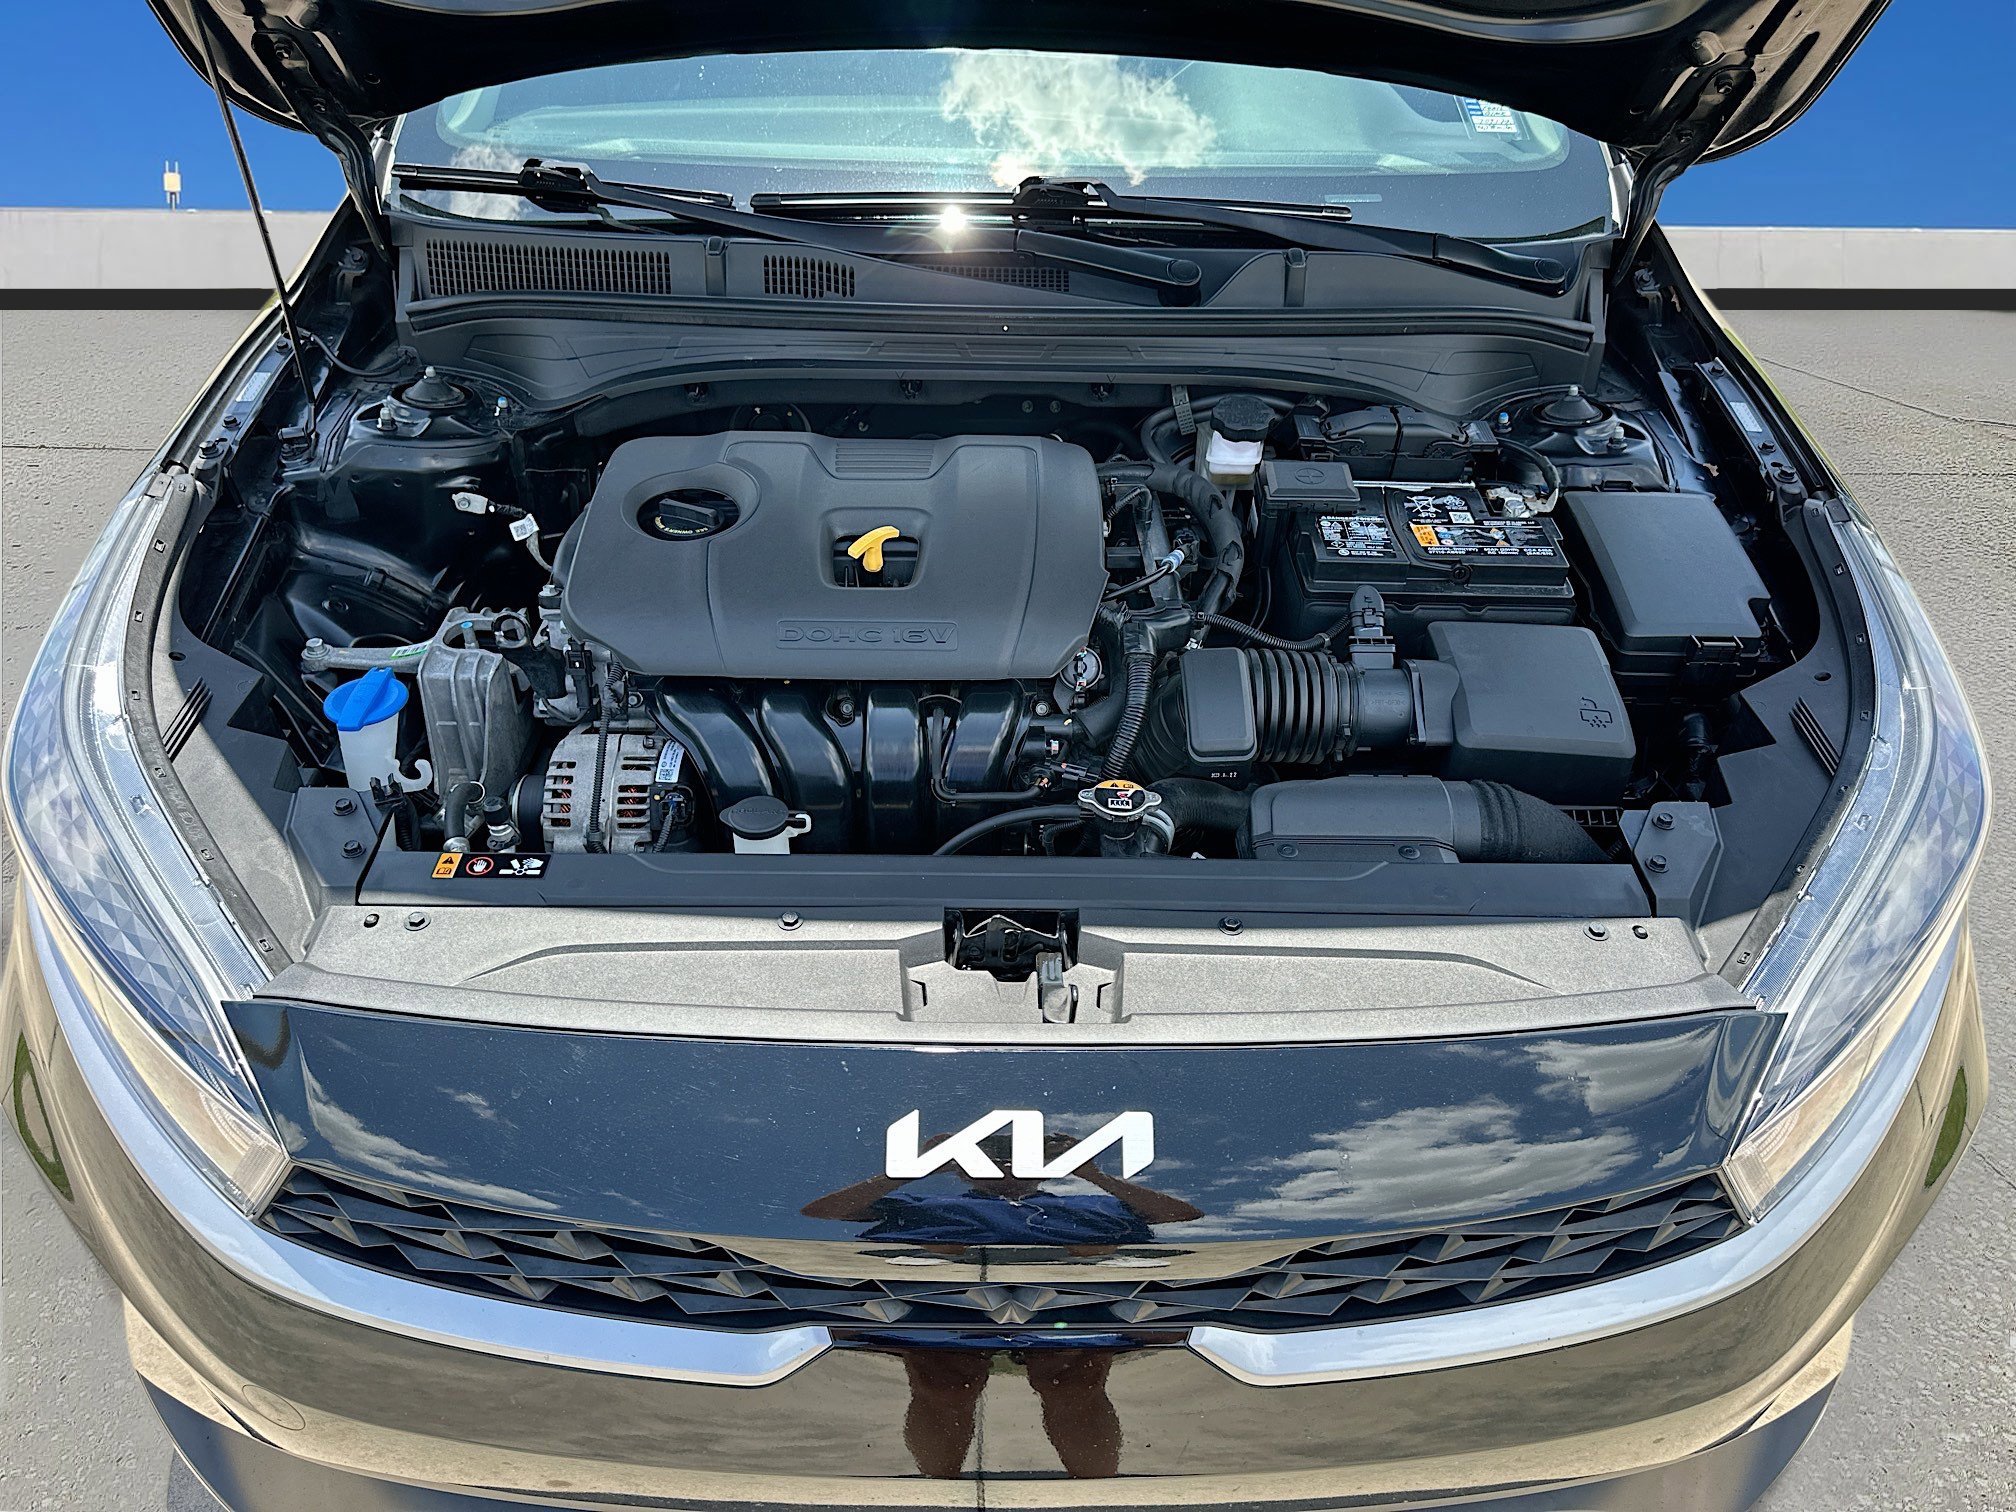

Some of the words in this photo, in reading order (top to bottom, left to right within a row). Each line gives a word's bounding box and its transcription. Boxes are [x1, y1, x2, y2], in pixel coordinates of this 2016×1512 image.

[779, 626, 883, 643] DOHC
[892, 627, 955, 645] 16V
[885, 1109, 1155, 1180] KIA
